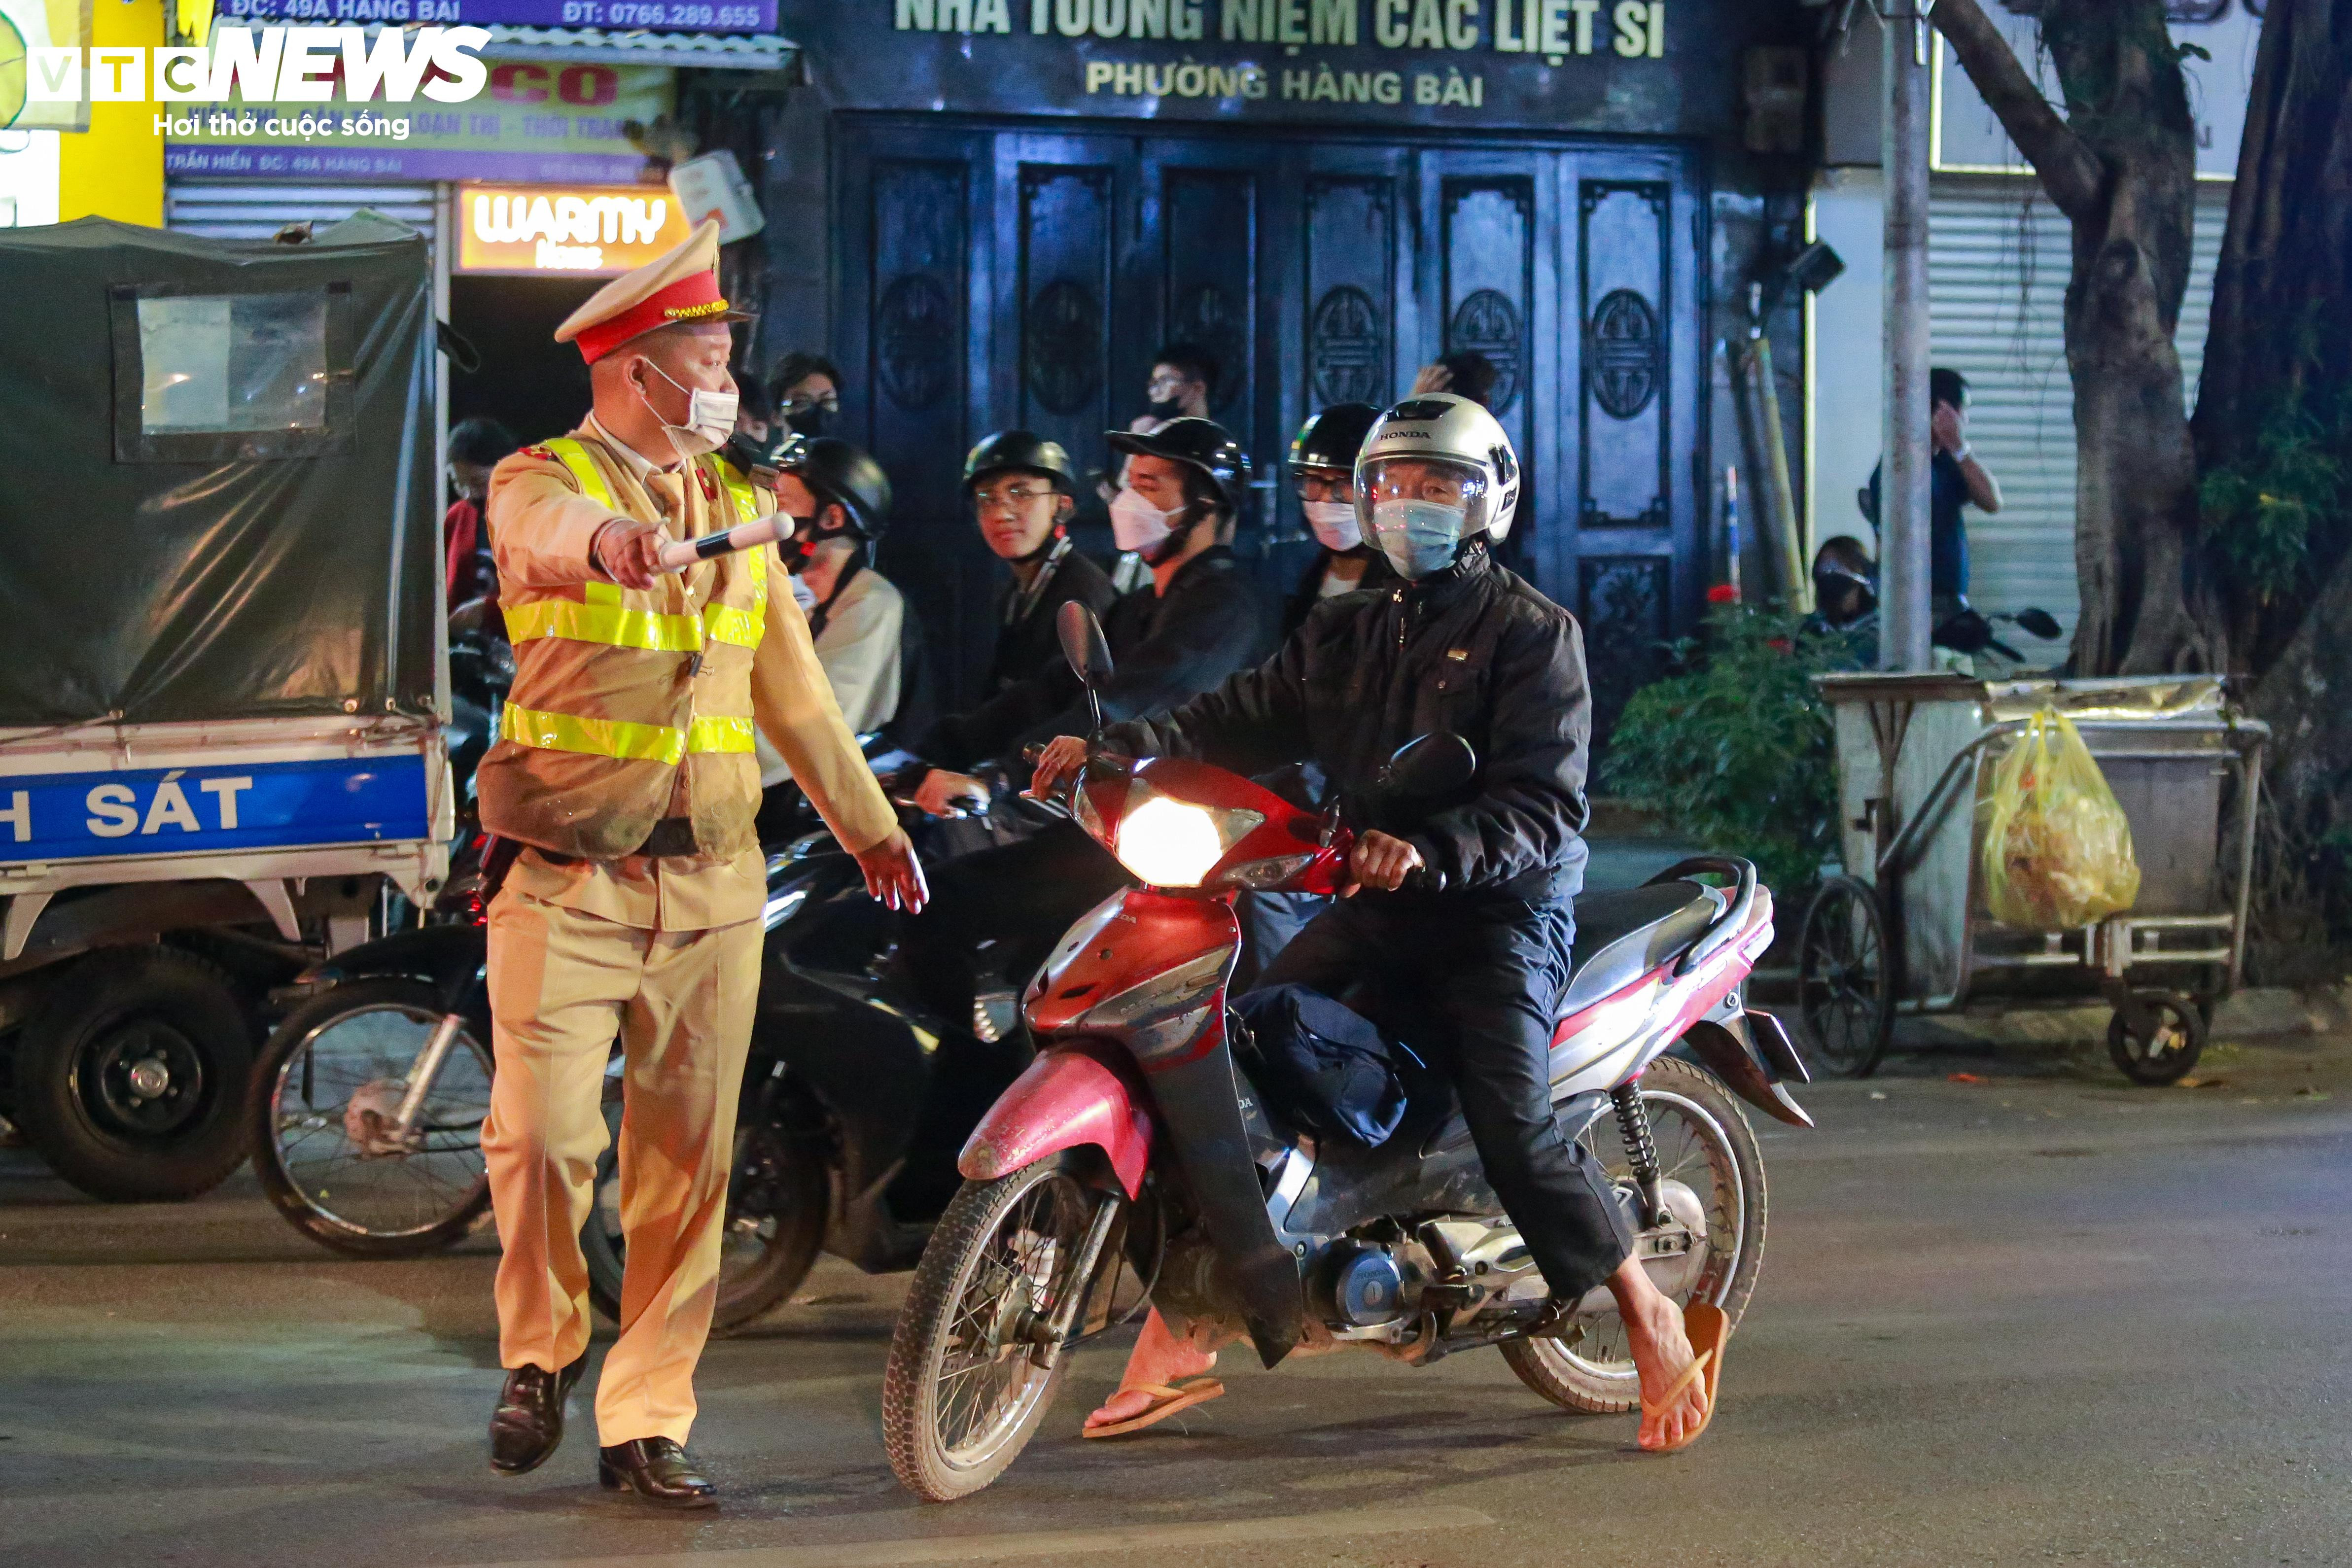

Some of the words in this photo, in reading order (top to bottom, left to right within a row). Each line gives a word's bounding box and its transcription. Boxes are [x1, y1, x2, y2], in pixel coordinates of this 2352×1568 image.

[1086, 54, 1269, 99] PHƯỜNG
[1282, 61, 1402, 104] HÀNG
[1415, 65, 1483, 107] BÀI
[1379, 431, 1431, 441] HONDA
[85, 770, 253, 838] SÁT
